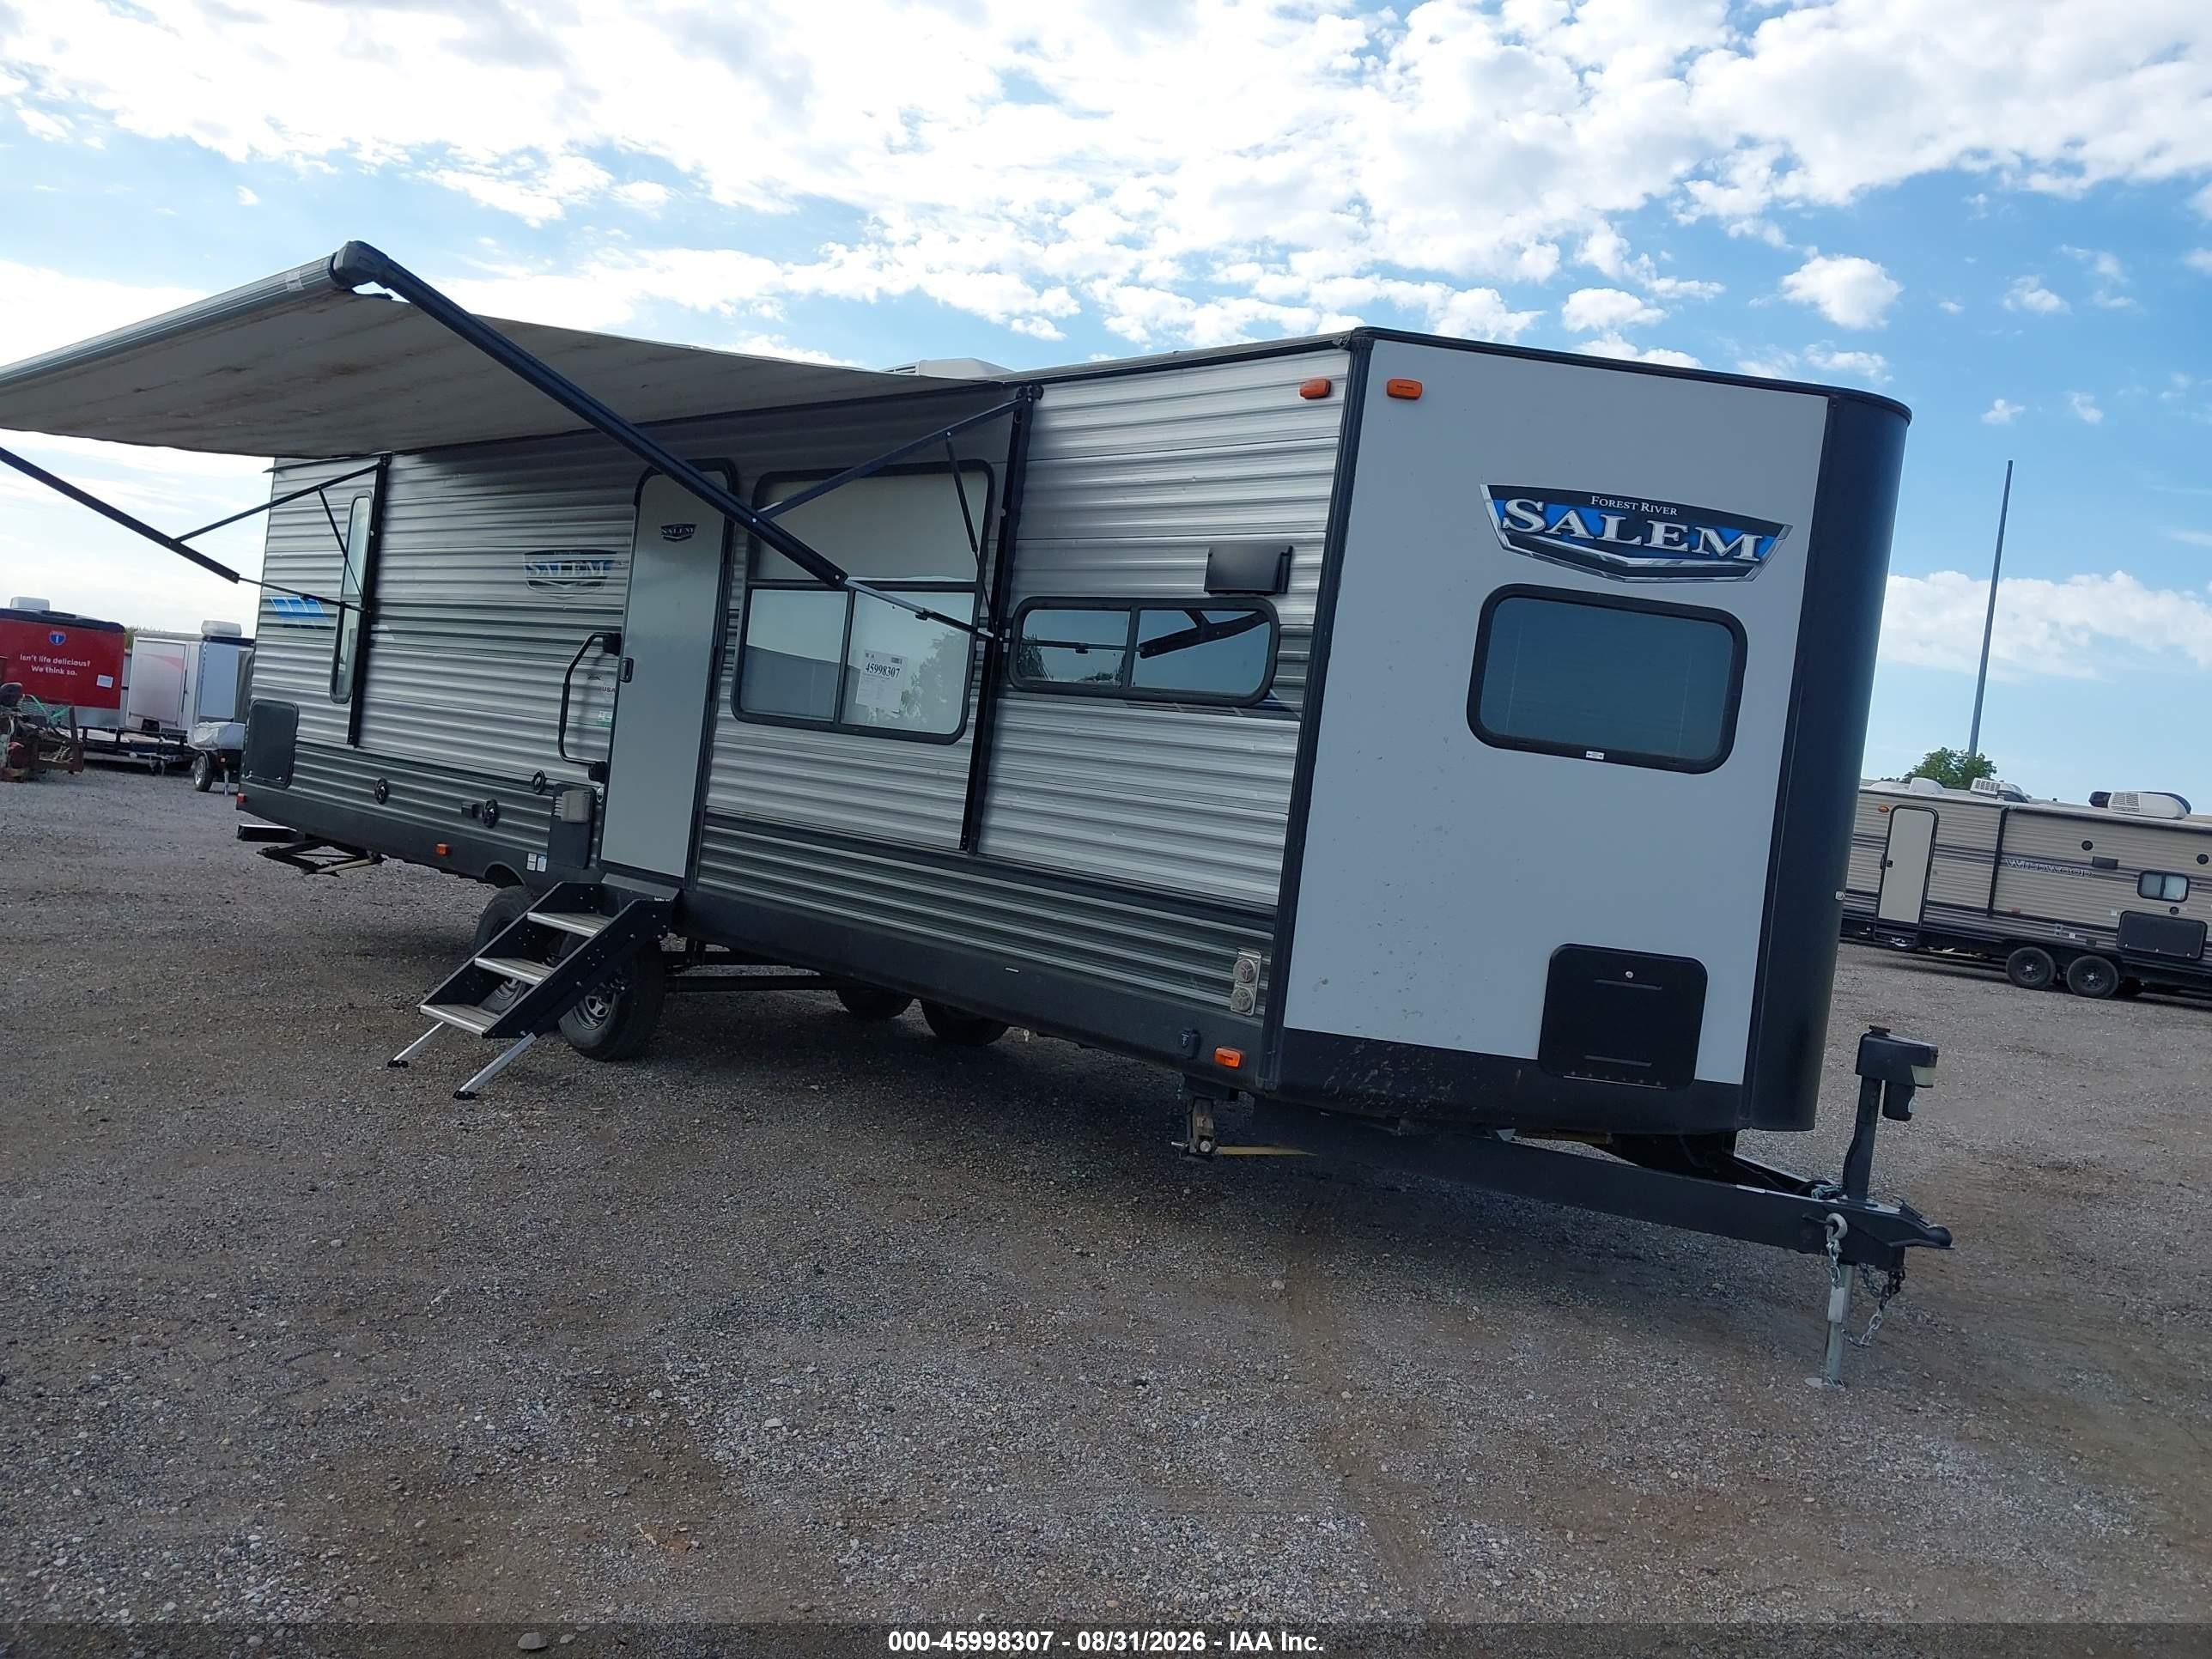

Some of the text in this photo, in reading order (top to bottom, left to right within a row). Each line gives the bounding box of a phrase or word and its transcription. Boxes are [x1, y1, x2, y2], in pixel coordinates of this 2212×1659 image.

[1591, 495, 1678, 516] FOREST RIVER
[1502, 498, 1765, 562] SALEM
[528, 561, 605, 577] SALEM
[46, 666, 64, 675] think
[52, 658, 90, 667] delicious?
[866, 662, 901, 679] 45998307
